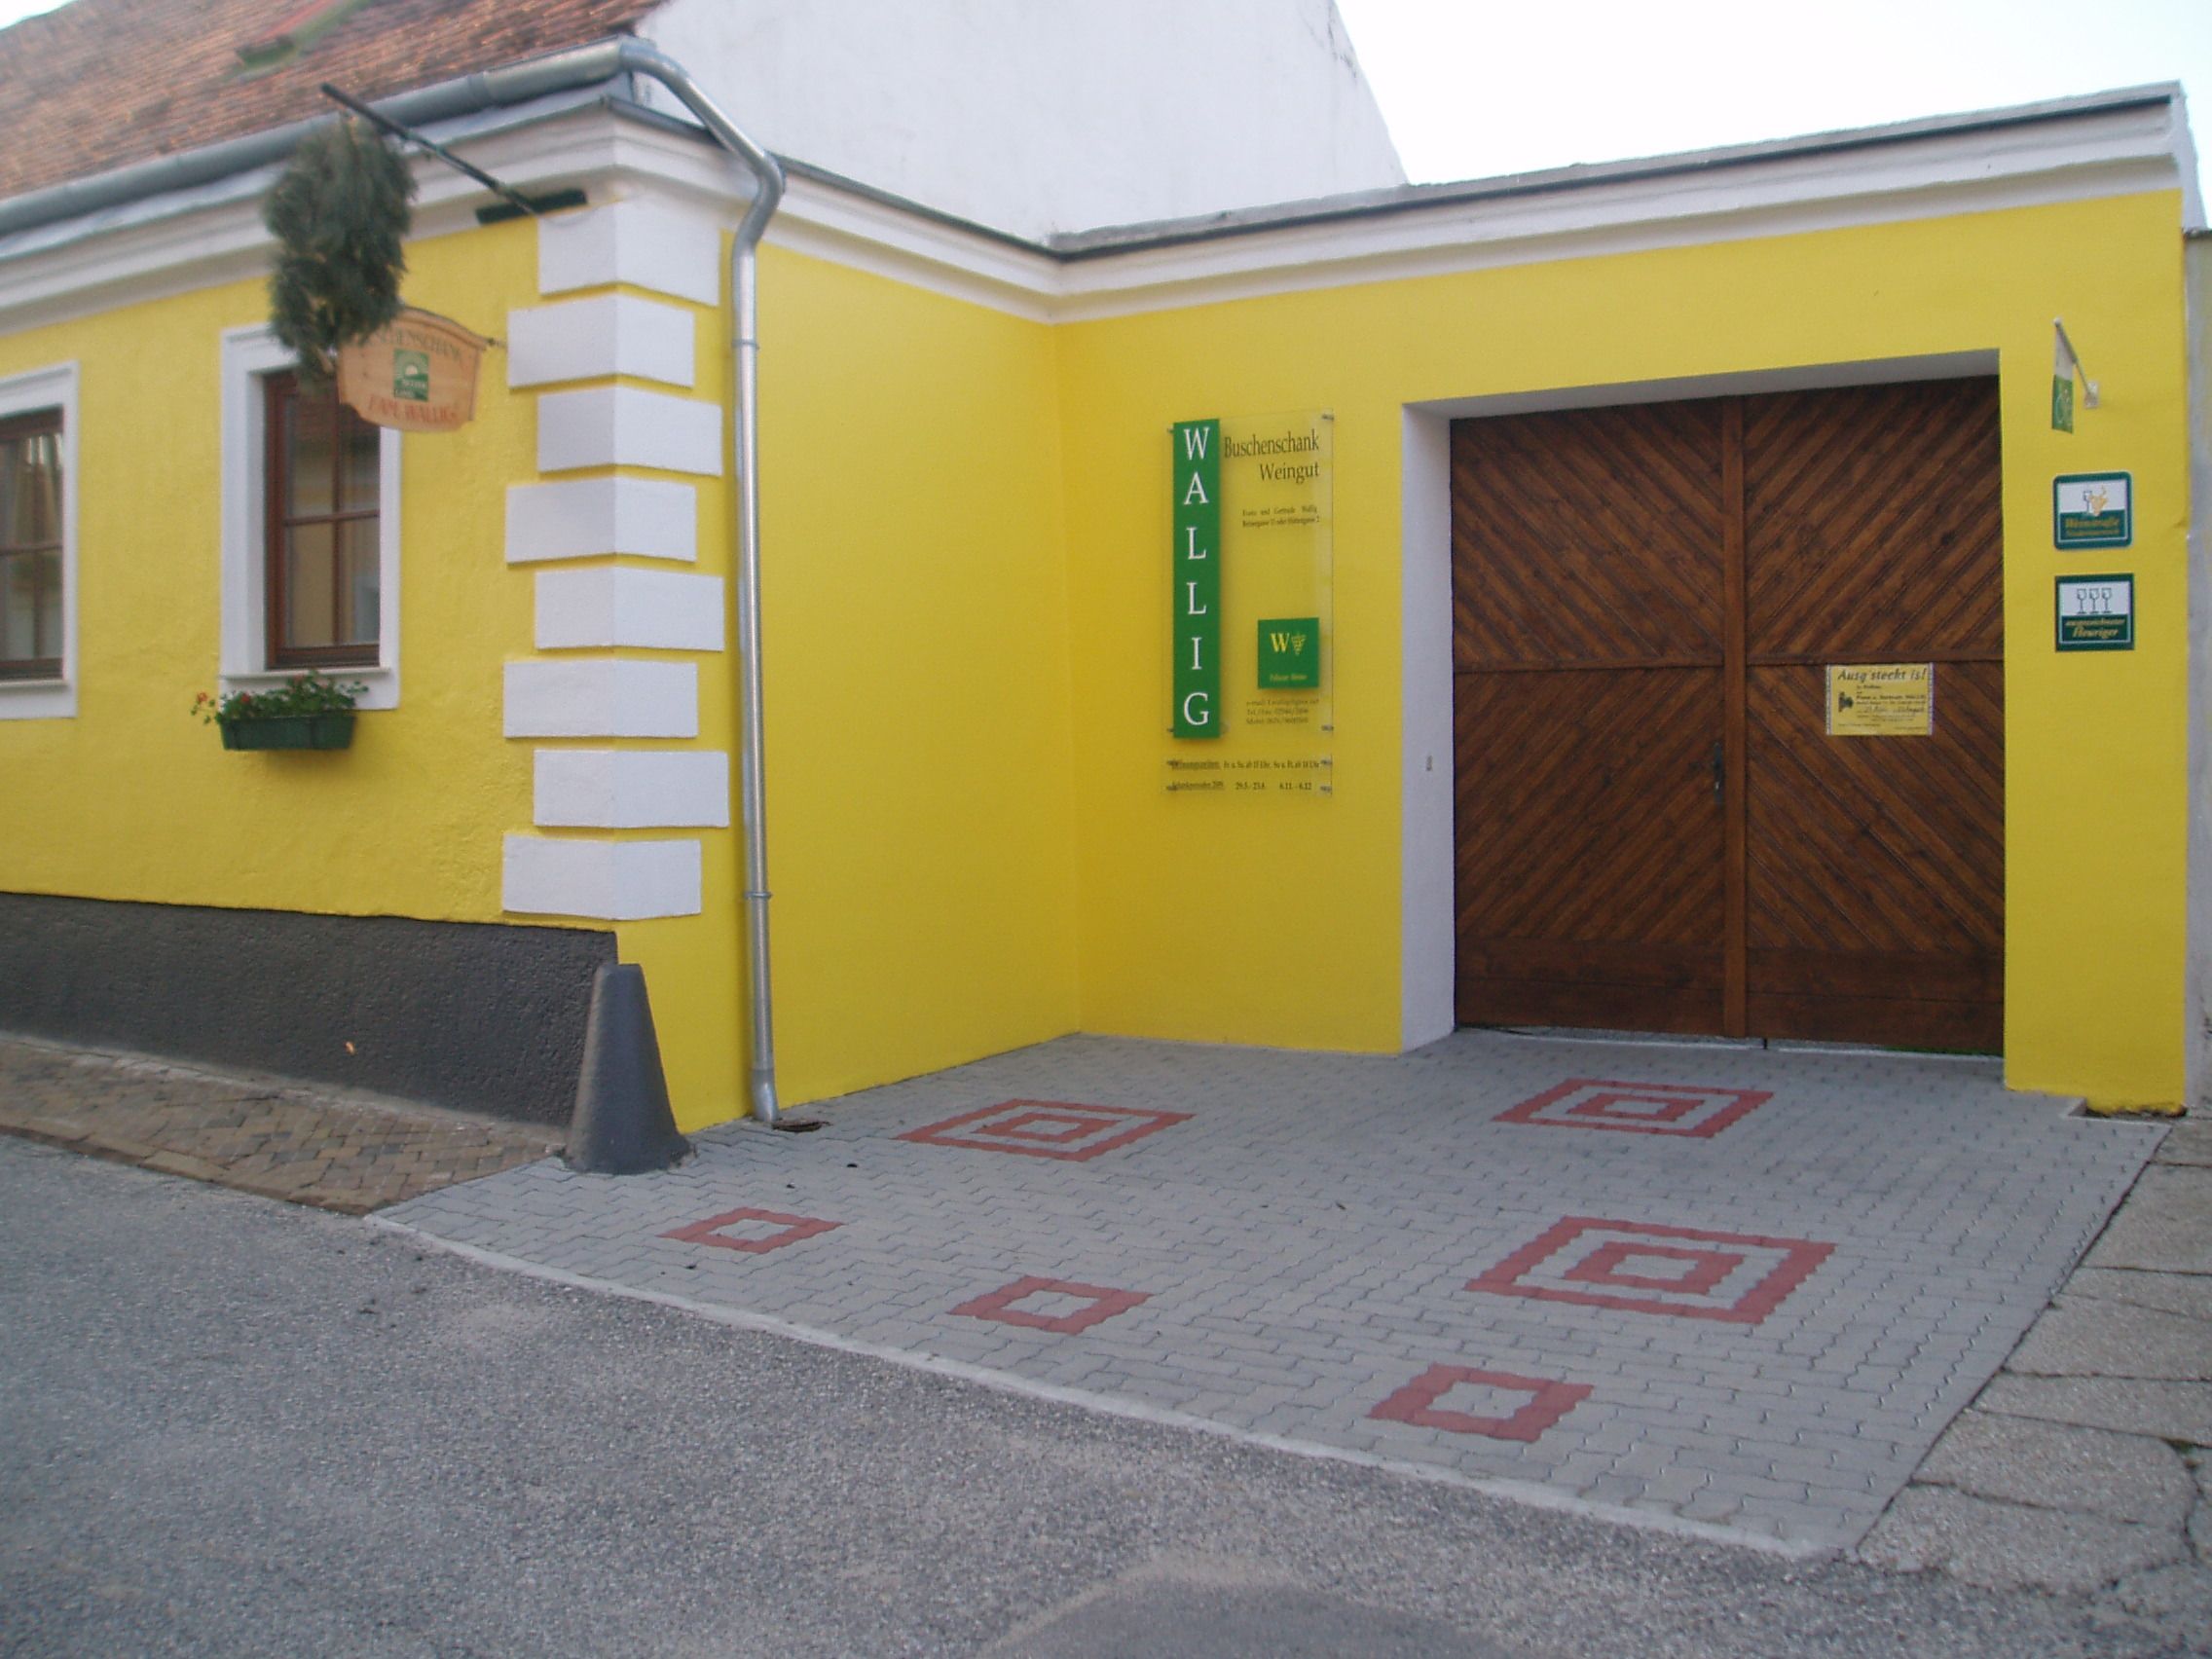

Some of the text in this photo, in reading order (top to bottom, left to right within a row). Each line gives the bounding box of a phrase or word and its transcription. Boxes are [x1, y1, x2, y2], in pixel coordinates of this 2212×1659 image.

[1224, 428, 1320, 459] Buschenschank
[1260, 462, 1320, 484] Weingut
[1183, 426, 1210, 726] WALLIG
[1270, 632, 1290, 652] W
